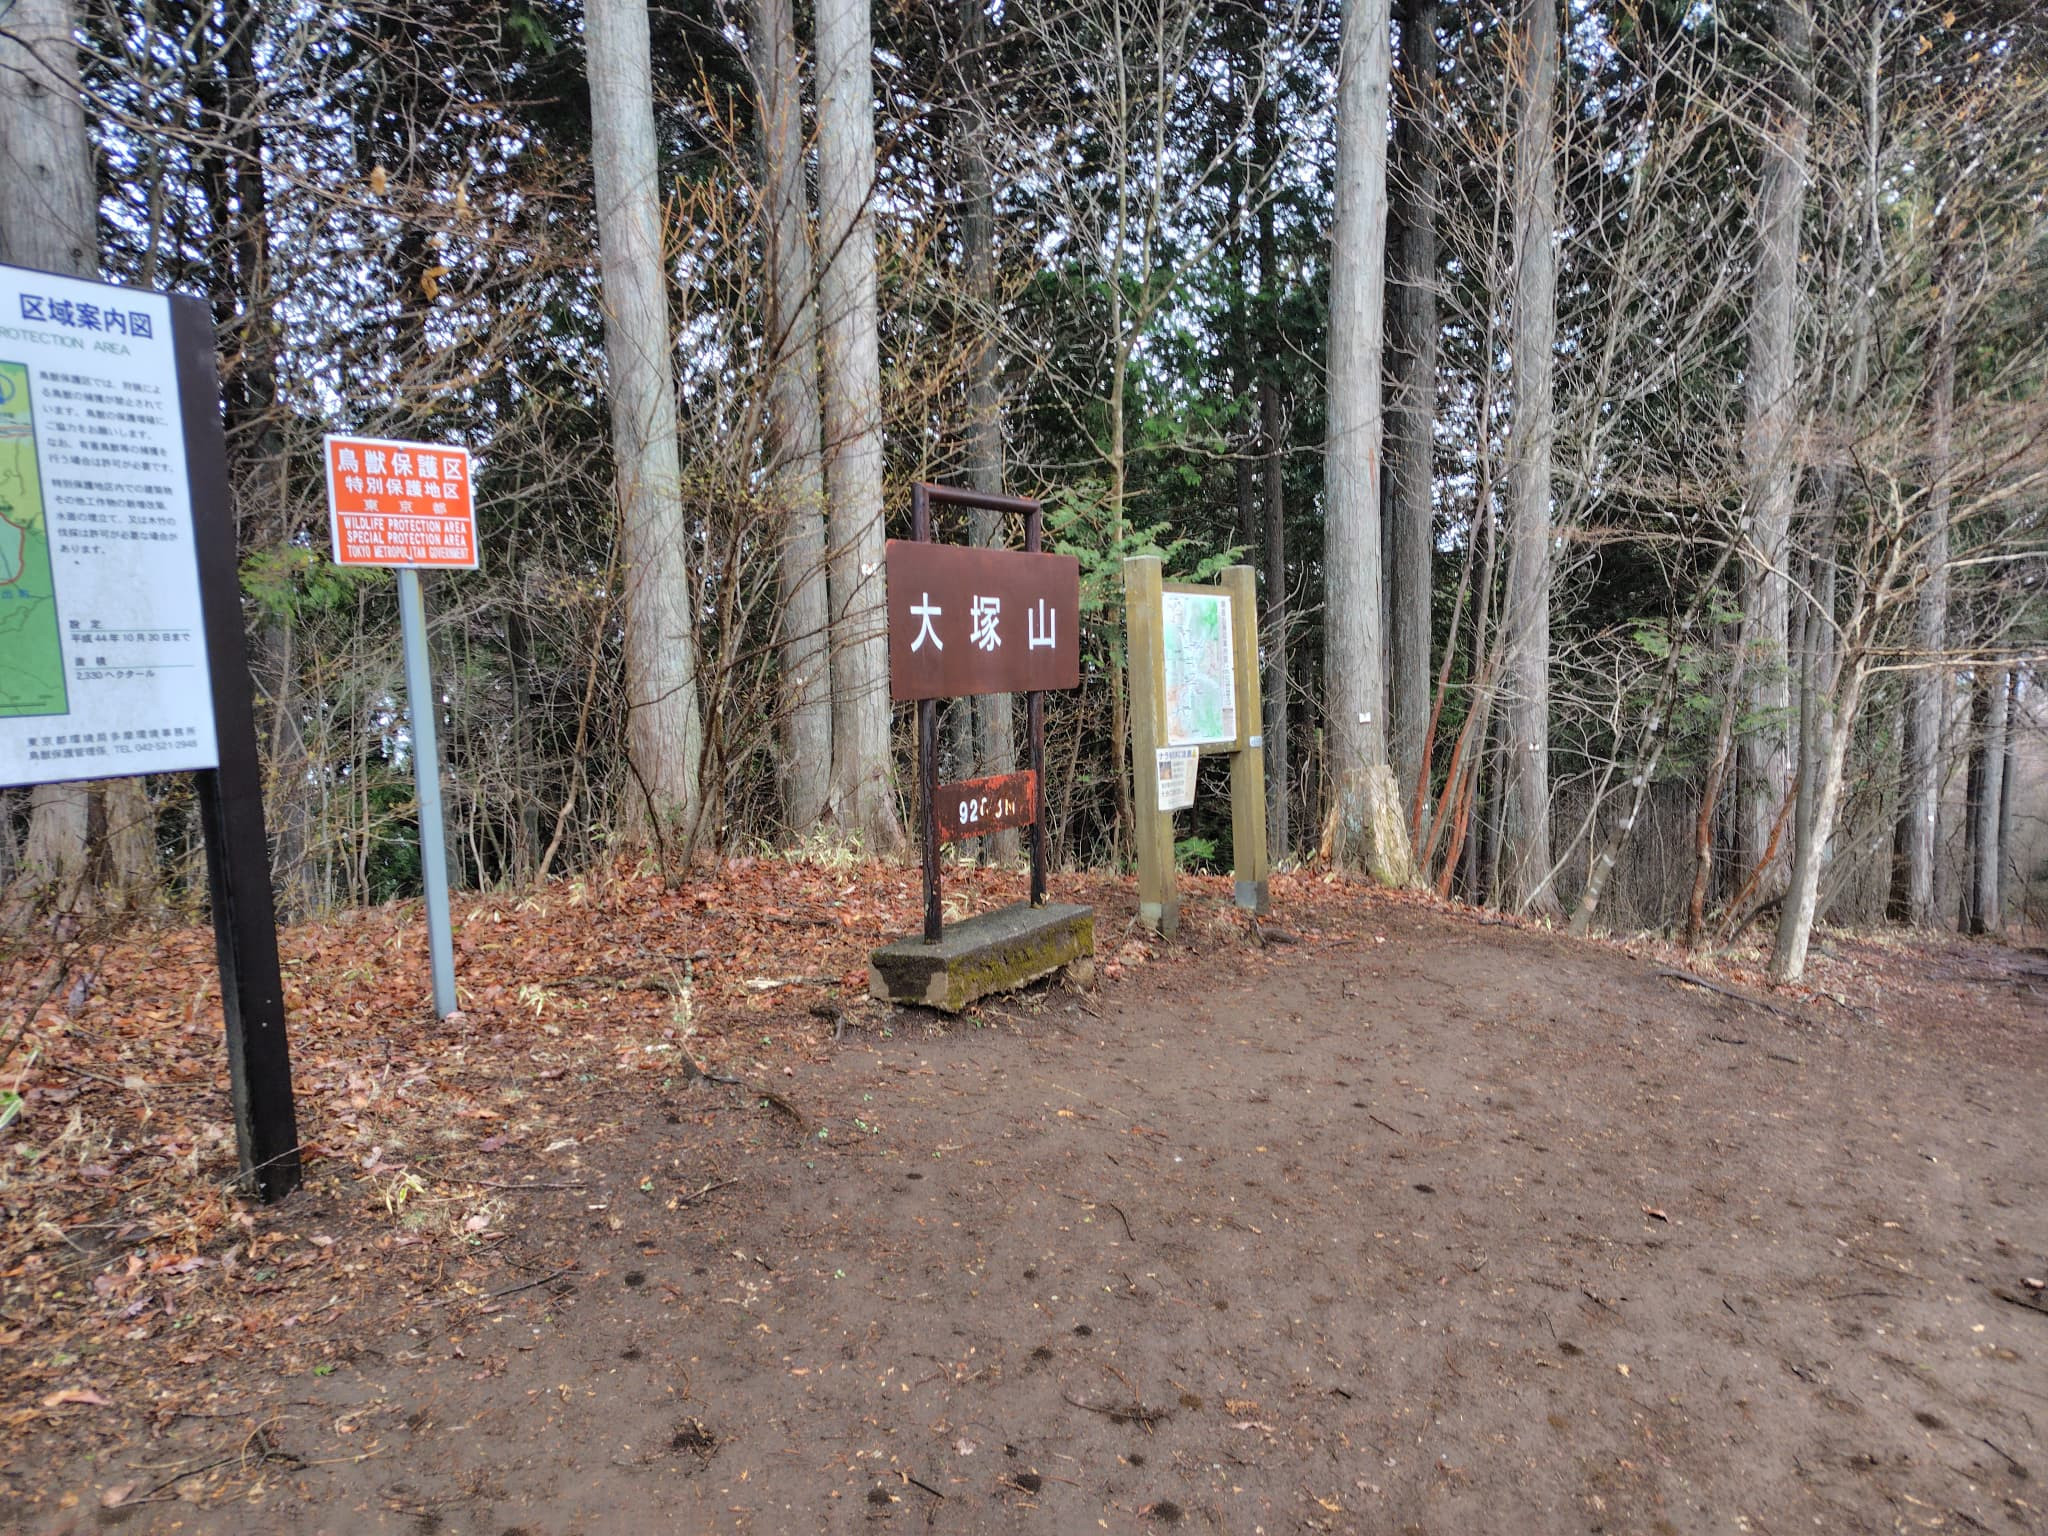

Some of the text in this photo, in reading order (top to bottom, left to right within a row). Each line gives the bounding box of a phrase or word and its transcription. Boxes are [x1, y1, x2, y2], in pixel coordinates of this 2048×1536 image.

[19, 292, 153, 339] 区域案内図
[93, 340, 131, 355] AREA
[338, 448, 463, 480] 鳥獣保護区
[345, 475, 459, 499] 特別保護地区
[363, 499, 447, 514] 東京都
[343, 517, 467, 534] WILDLIFE PROTECTION AREA
[347, 530, 467, 546] SPECIAL PROTECTION AREA
[346, 545, 469, 559] TOKYO METROPOLITAN GOVERNMENT
[910, 591, 1057, 653] 大塚山
